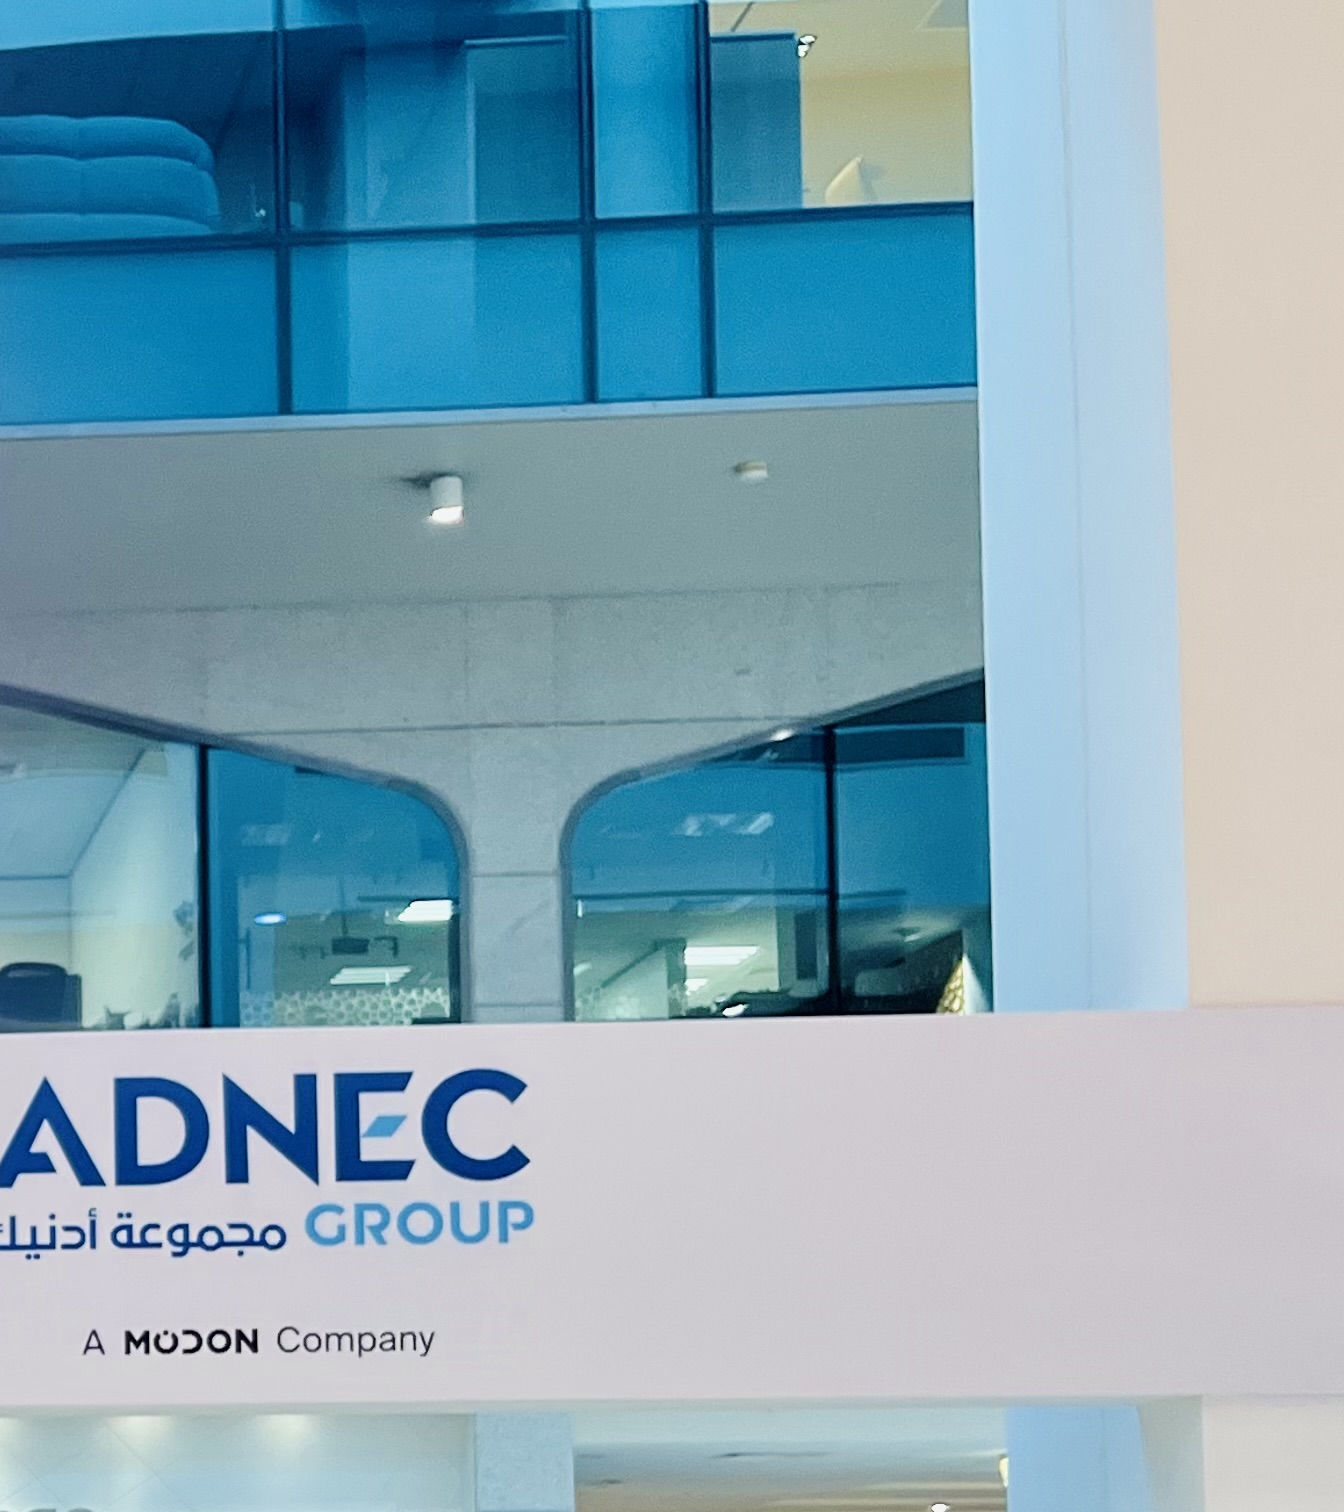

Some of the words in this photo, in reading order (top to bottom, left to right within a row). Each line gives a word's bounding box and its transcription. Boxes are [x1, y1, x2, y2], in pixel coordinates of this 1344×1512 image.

[111, 1212, 288, 1258] مجموعة
[304, 1200, 534, 1248] GROUP
[82, 1328, 106, 1356] A
[276, 1325, 436, 1358] Company
